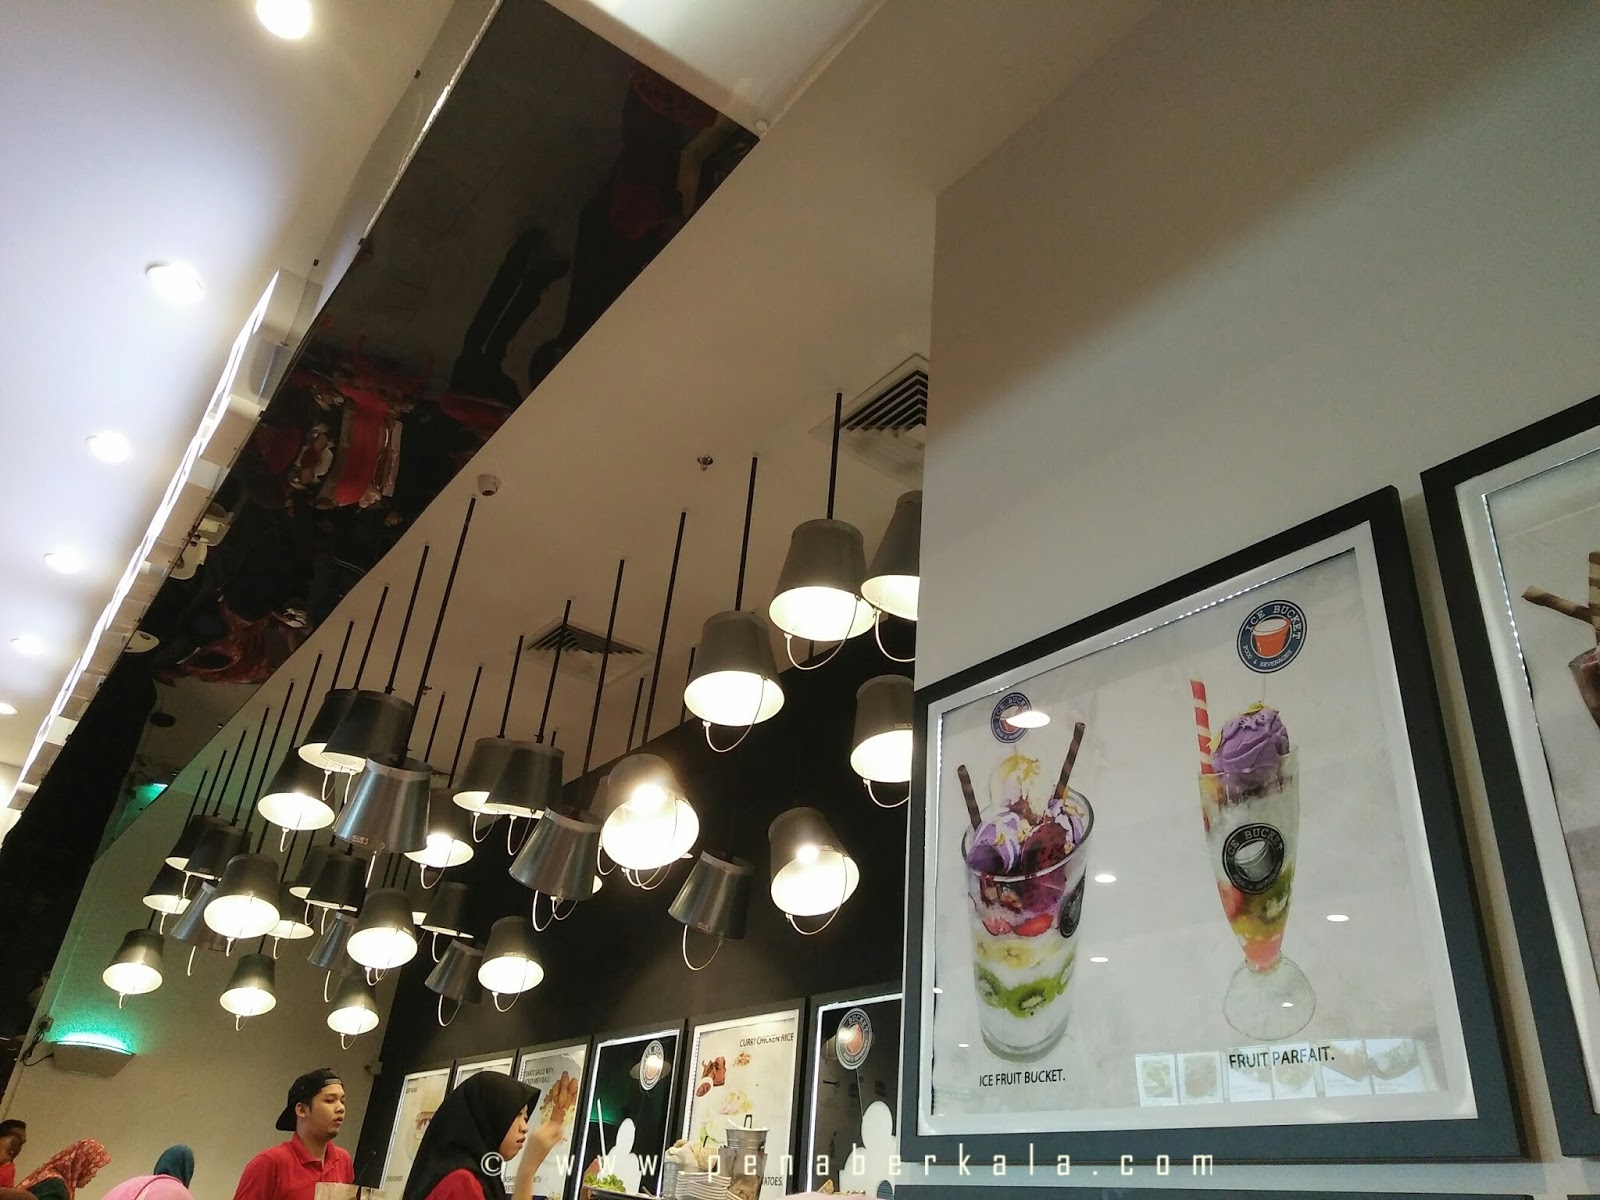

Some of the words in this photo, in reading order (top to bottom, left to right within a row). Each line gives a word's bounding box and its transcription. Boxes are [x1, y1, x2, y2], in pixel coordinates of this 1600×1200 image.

[1245, 610, 1266, 633] ICE
[1272, 605, 1302, 640] BUCKET
[994, 703, 1006, 720] ICE
[739, 1037, 756, 1048] CURRY
[756, 1034, 780, 1045] CHICKEN
[780, 1032, 795, 1042] RICE
[1228, 1052, 1269, 1069] FRUIT
[1272, 1046, 1335, 1066] PARFAIT.
[979, 1074, 994, 1087] ICE
[995, 1071, 1022, 1086] FRUIT
[1024, 1068, 1066, 1084] BUCKET.
